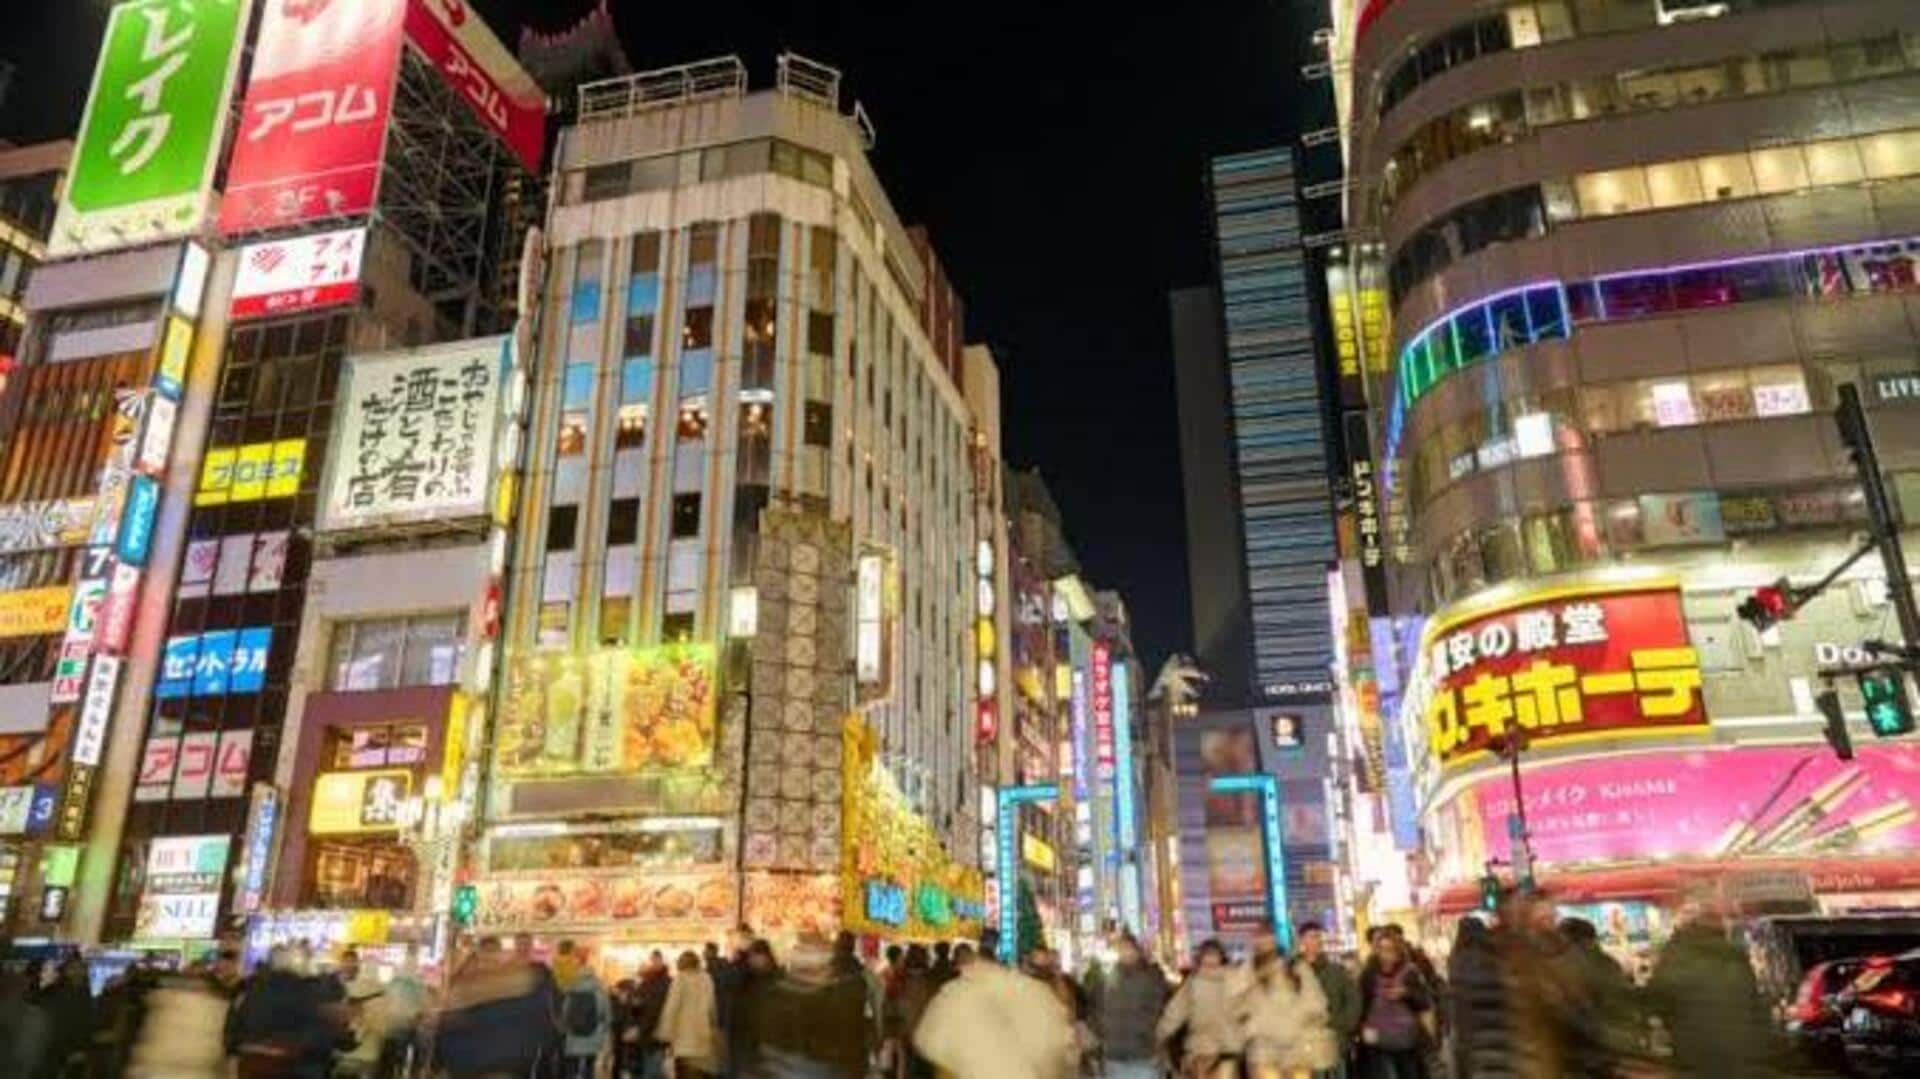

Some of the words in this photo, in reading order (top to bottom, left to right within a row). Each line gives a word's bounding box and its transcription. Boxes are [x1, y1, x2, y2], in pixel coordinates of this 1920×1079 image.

[110, 5, 193, 175] レイク
[249, 83, 379, 142] アコム
[445, 53, 509, 130] アコム
[139, 740, 249, 780] アコム
